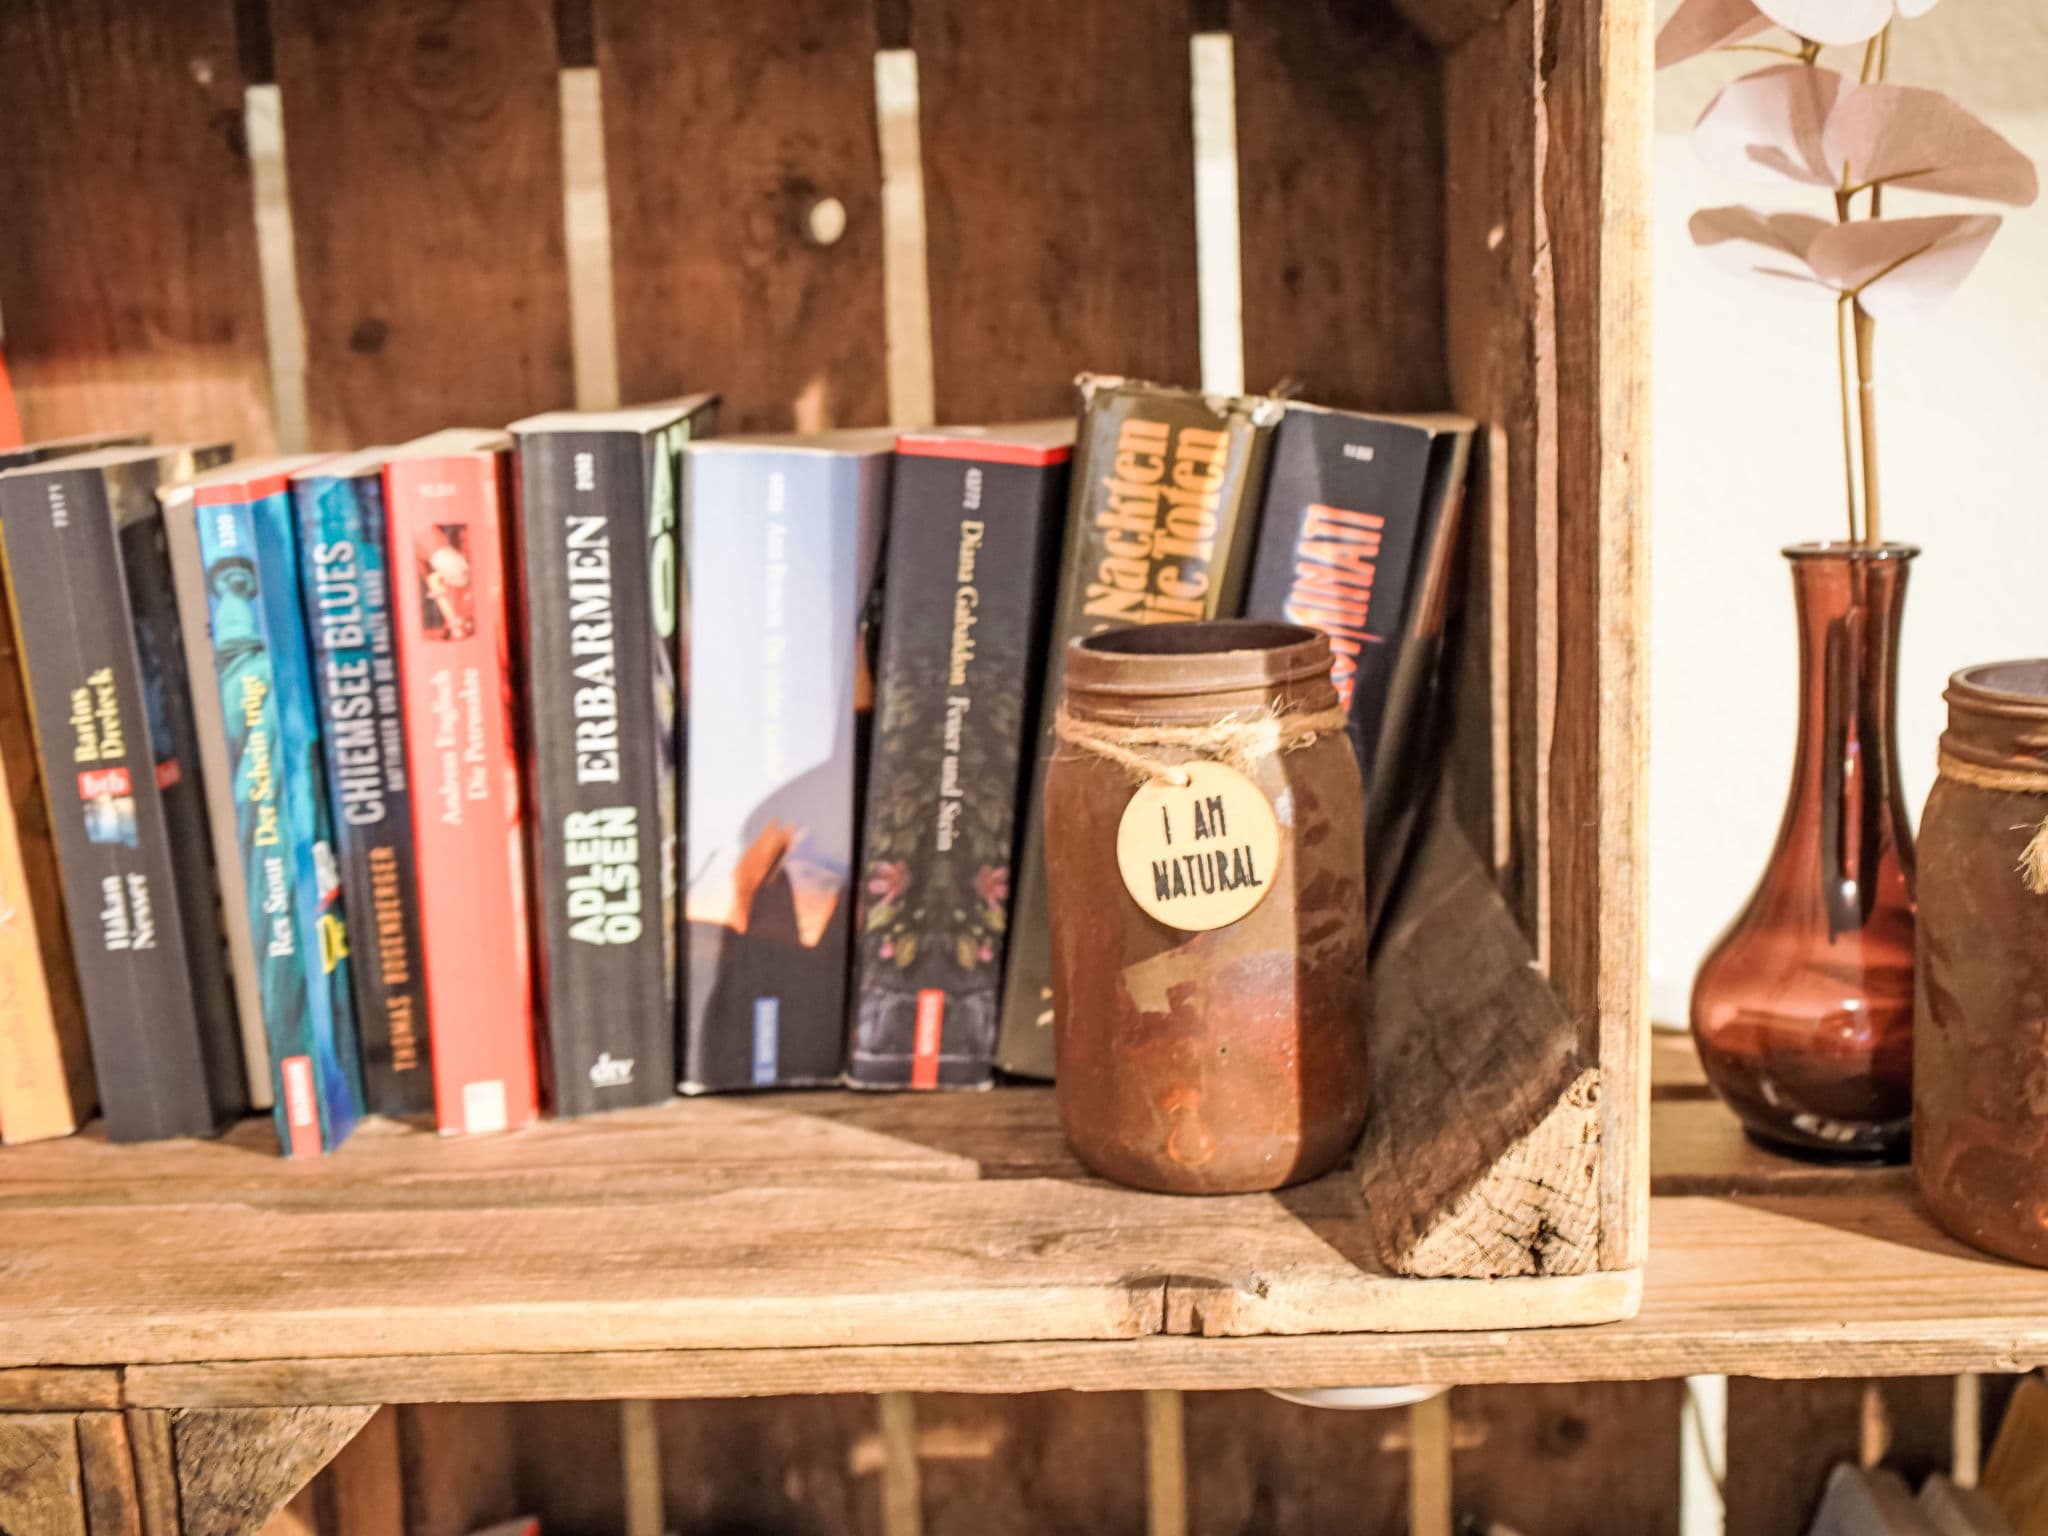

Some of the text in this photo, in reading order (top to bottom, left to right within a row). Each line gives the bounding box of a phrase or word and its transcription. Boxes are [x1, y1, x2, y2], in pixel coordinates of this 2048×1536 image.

[1152, 426, 1230, 562] Toten
[957, 520, 985, 583] Diana
[566, 515, 620, 784] ERBARMEN
[949, 586, 980, 686] Gabaldon
[88, 667, 126, 760] Dreieck
[313, 540, 387, 826] CHIEMSEE BLUES
[375, 684, 398, 714] UND
[71, 687, 99, 763] Barins
[943, 696, 971, 754] Feuer
[244, 731, 276, 802] Schein
[940, 755, 965, 799] und
[253, 803, 281, 847] Der
[936, 799, 963, 852] Stein
[1161, 794, 1227, 846] I AM
[262, 856, 289, 914] Stout
[564, 808, 607, 945] ADLER
[600, 806, 643, 944] OLSEN
[1151, 844, 1264, 902] NATURAL
[266, 916, 296, 958] Rex
[386, 994, 418, 1072] THOMAS
